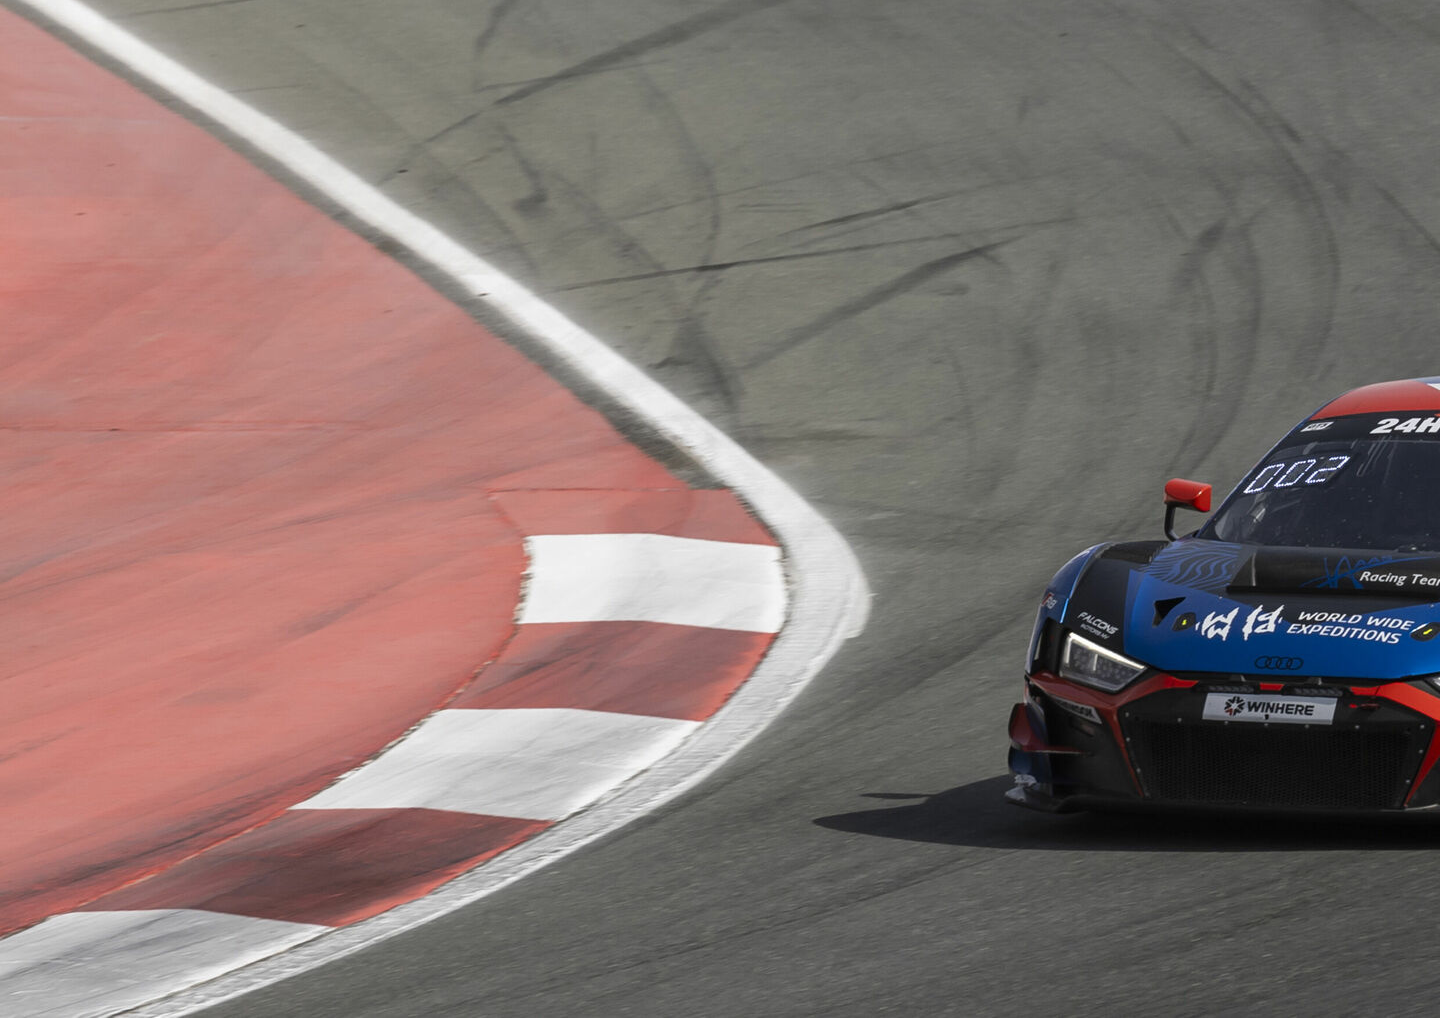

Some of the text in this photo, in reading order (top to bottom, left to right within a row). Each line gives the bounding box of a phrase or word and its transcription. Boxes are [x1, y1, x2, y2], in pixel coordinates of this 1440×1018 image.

[1243, 456, 1350, 494] 002
[1360, 571, 1407, 586] Racing
[1077, 612, 1119, 635] FALCONS
[1298, 611, 1415, 631] WORLD WIDE
[1286, 623, 1402, 644] EXPEDITIONS
[1247, 701, 1315, 716] WINHERE
